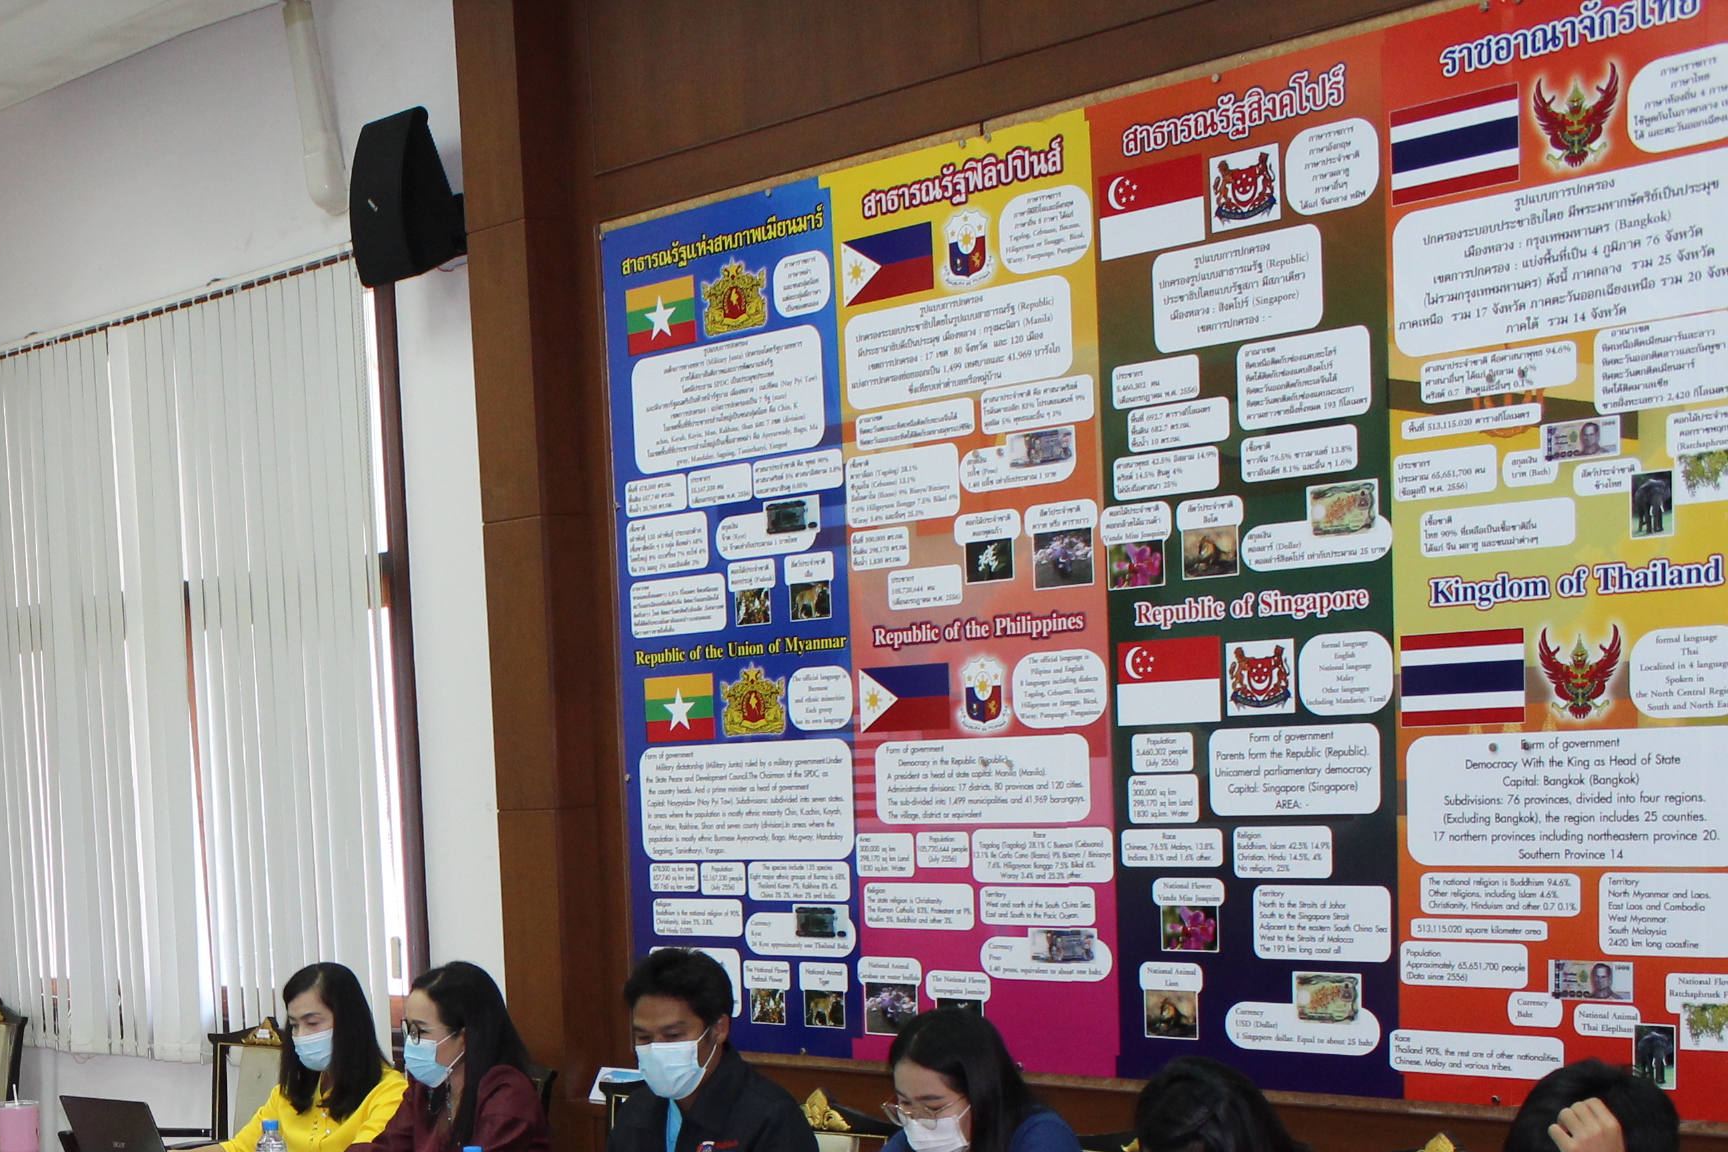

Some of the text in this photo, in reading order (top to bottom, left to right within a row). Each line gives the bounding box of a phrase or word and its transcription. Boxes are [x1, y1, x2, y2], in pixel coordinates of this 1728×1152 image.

[1123, 62, 1345, 155] สาธารณรัฐสิงคโปร์
[863, 136, 1063, 217] สาธารณรัฐฟิลิปปินส์
[1430, 554, 1723, 609] Kingdom of Thailand
[1135, 589, 1369, 628] Republic of Singapore
[874, 613, 1084, 648] Republic of the Philippines
[636, 636, 847, 667] Republic of the Union of Myanmar
[1680, 646, 1699, 656] Thai
[1248, 729, 1334, 743] Form of government
[1547, 737, 1559, 749] of
[1215, 744, 1370, 761] Parents form the Republic (Republic).
[1214, 762, 1372, 779] Unicameral parliamentary democracy
[1464, 752, 1681, 772] Democracy With the King as Head of State
[1227, 780, 1359, 796] Capital: Singapore (Singapore)
[1501, 771, 1640, 790] Capital: Bangkok (Bangkok)
[1443, 789, 1706, 808] Subdivisions: 76 provinces, divided into four regions.
[1442, 809, 1707, 827] (Excluding Bangkok), the region includes 25 counties.
[1433, 828, 1720, 845] 17 northern provinces including northeastern province 20.
[1517, 847, 1624, 860] Southern Province 14
[1607, 876, 1640, 888] Territory
[1671, 888, 1688, 899] and
[1607, 900, 1624, 910] East
[1625, 901, 1644, 911] Laos
[1644, 901, 1662, 911] and
[1607, 913, 1670, 925] West Myanmar.
[1630, 937, 1643, 947] km
[1644, 938, 1663, 951] long
